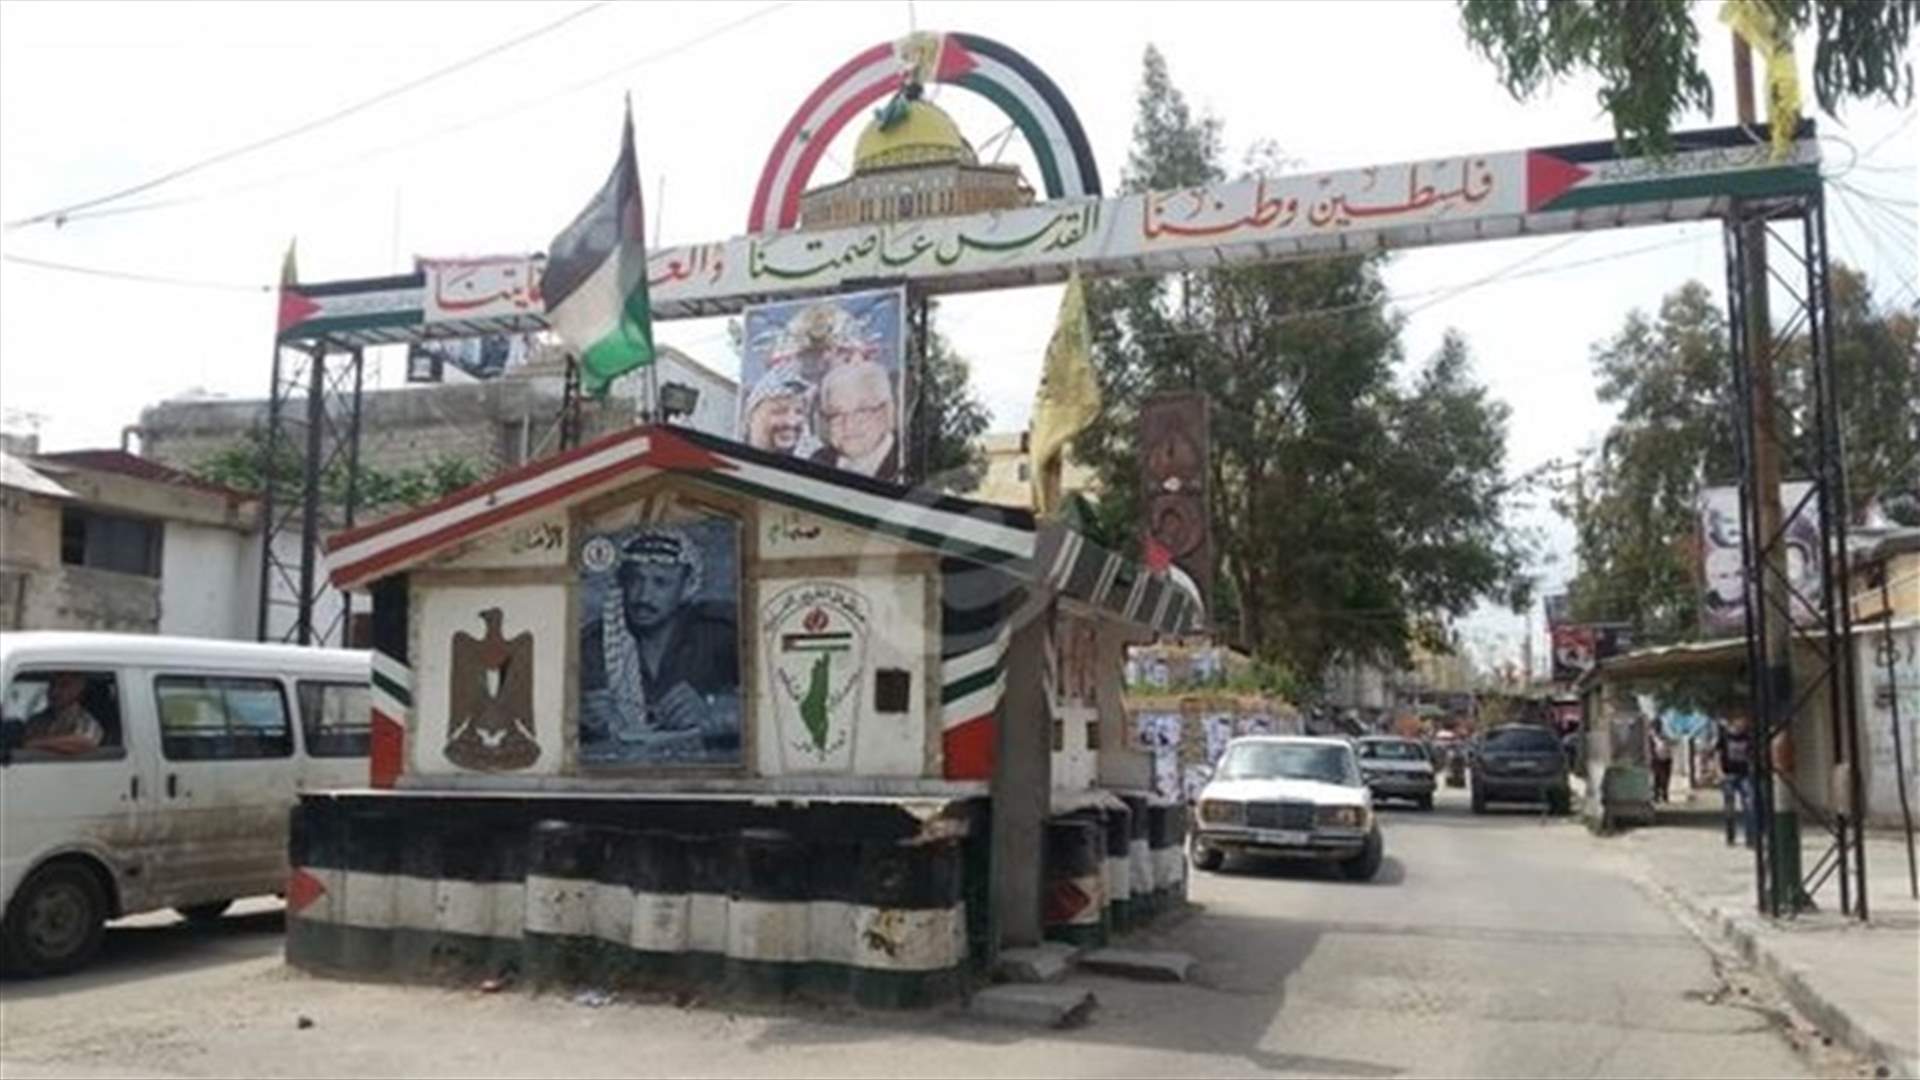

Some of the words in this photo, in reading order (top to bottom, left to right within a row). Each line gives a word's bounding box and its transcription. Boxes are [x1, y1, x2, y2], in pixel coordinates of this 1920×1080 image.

[1143, 171, 1298, 239] وطننا
[1308, 156, 1493, 226] فلسطين
[750, 228, 935, 279] عاصمتنا
[935, 202, 1099, 266] القدس
